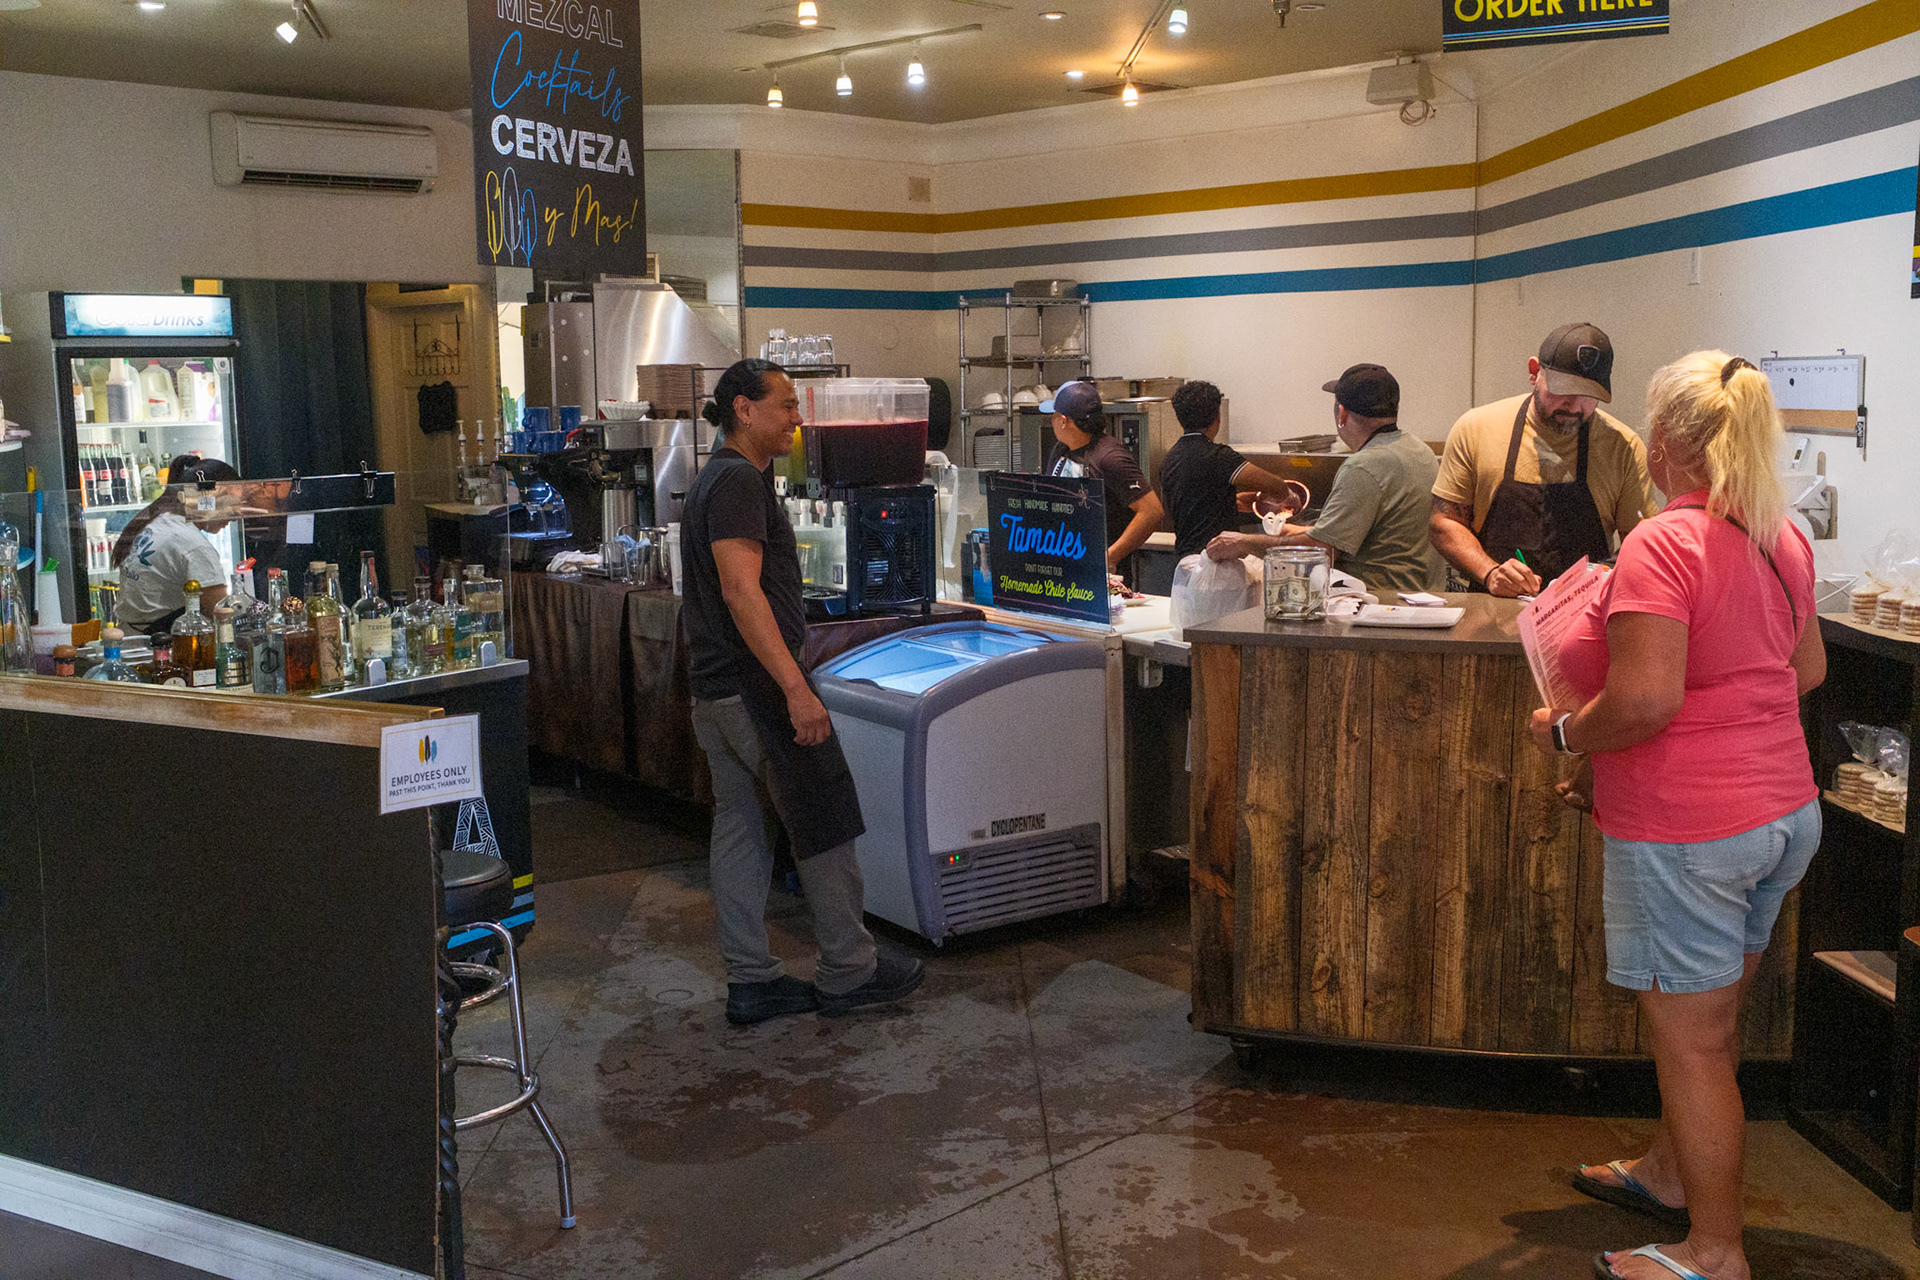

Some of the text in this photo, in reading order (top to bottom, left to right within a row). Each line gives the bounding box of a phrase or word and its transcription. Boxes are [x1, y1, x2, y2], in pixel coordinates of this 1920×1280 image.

[497, 0, 623, 48] MEZCAL
[491, 30, 631, 122] Cocktails
[491, 114, 634, 176] CERVEZA
[544, 206, 565, 246] y
[152, 312, 204, 327] Drinks
[1000, 512, 1087, 560] Tamales
[1000, 575, 1095, 603] Homemade Chile Sauce
[1573, 575, 1599, 597] TEQUILA
[389, 789, 403, 797] PAST
[417, 783, 437, 792] POINT,
[437, 780, 456, 788] THANK
[458, 777, 471, 785] YOU
[391, 765, 468, 787] EMPLOYEES ONLY
[991, 812, 1045, 837] CYCLOPENTANE
